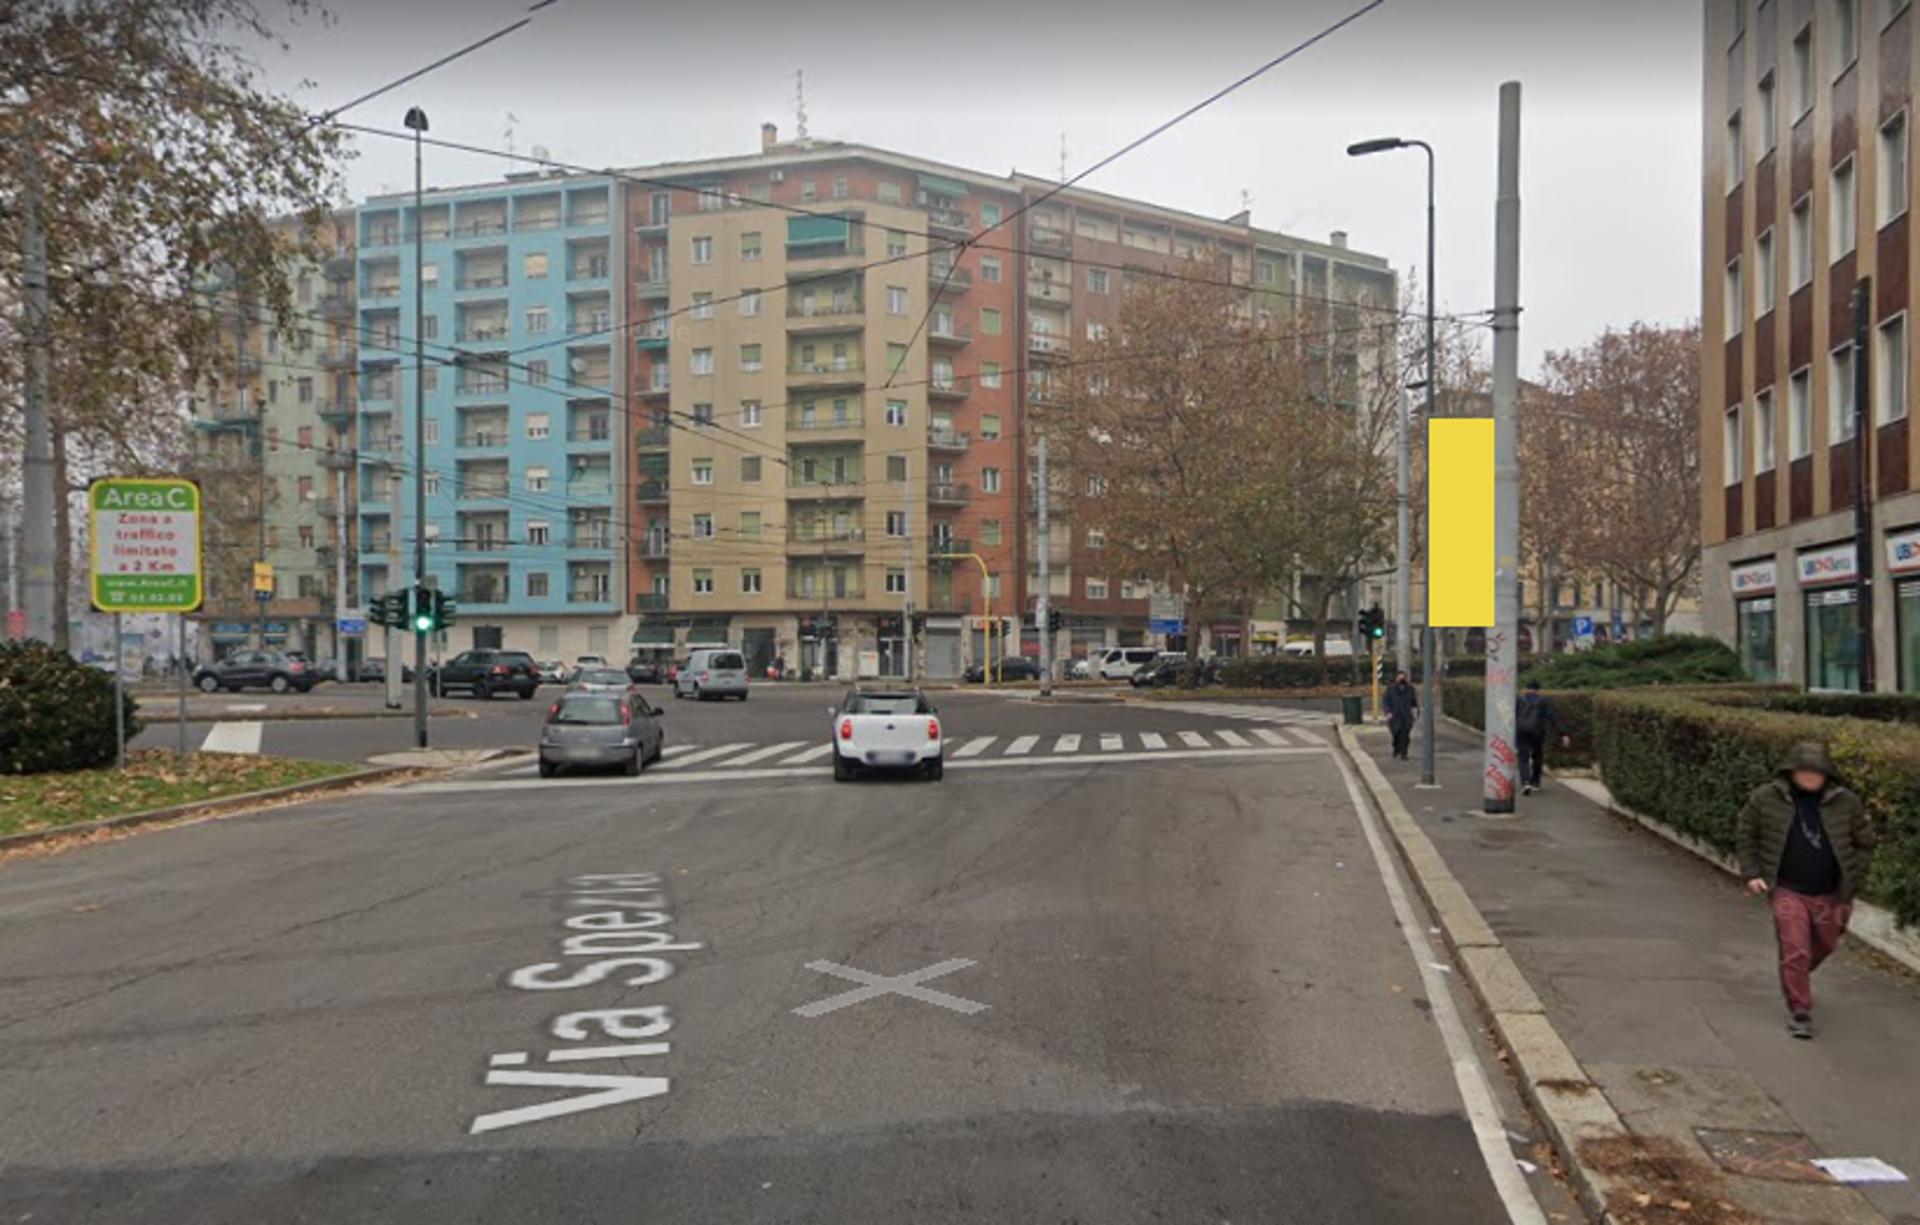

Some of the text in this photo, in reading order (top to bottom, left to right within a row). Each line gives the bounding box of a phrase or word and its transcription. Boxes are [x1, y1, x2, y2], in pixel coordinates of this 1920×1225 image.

[117, 513, 173, 524] Zona a
[115, 527, 176, 541] traffico
[113, 544, 178, 557] limitato
[117, 561, 175, 571] a 2 Km
[1575, 618, 1588, 635] P
